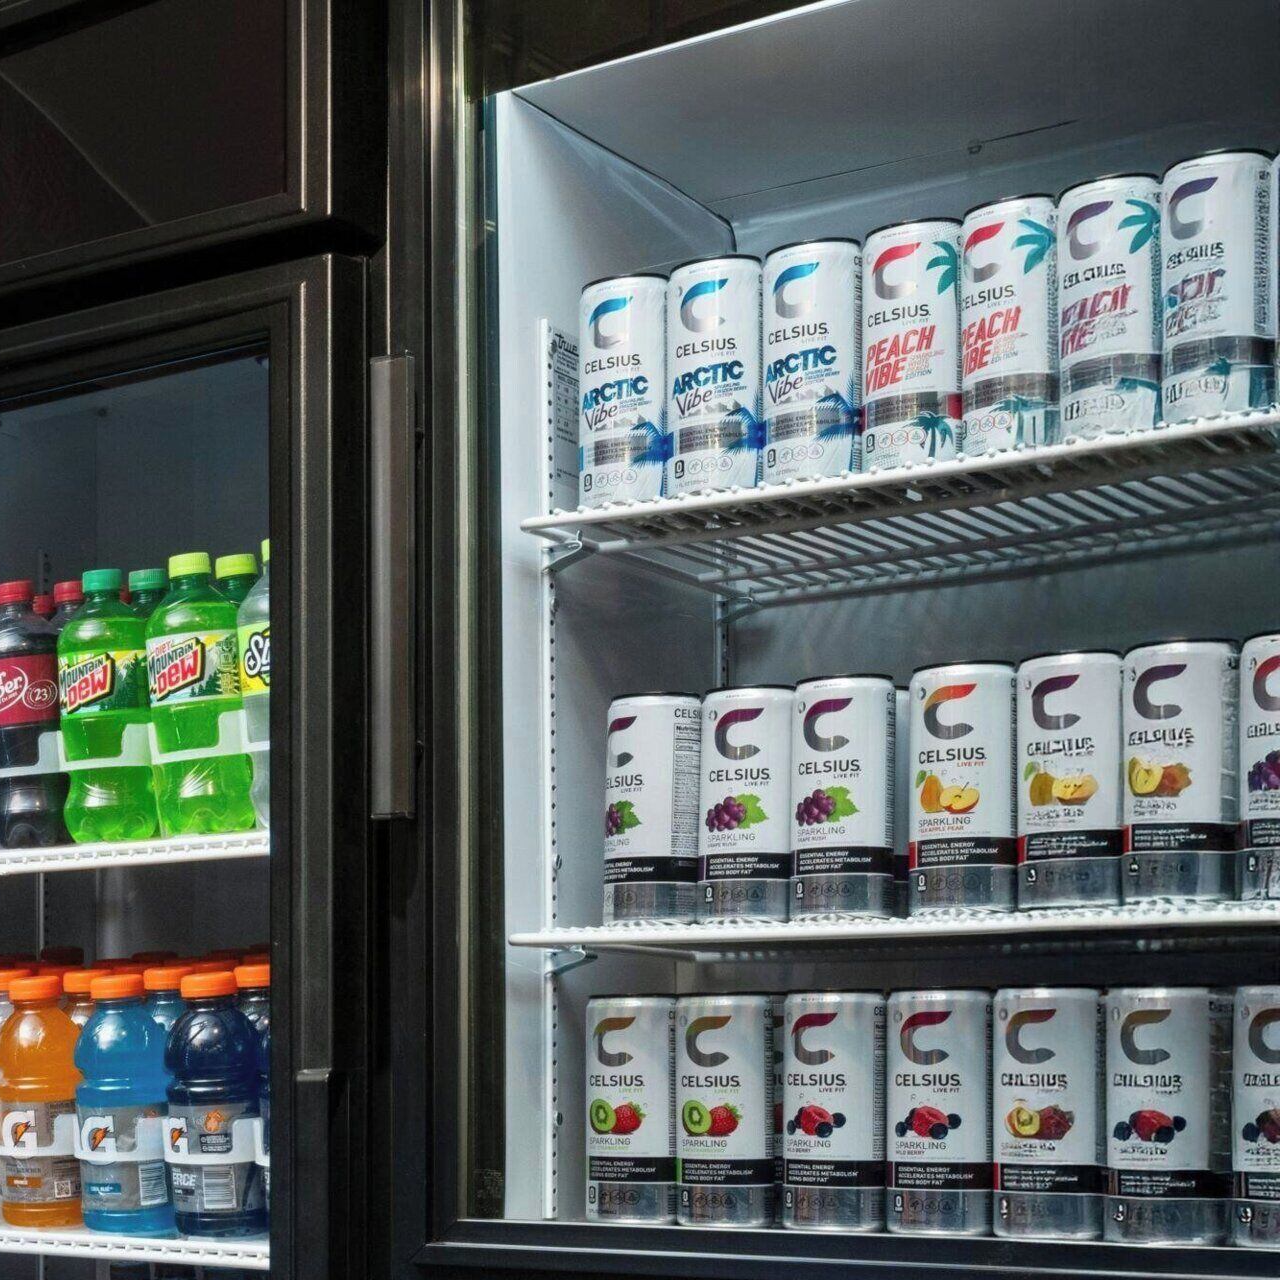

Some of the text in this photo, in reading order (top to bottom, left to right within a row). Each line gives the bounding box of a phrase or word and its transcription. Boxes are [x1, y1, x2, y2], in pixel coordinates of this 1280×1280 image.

[868, 304, 930, 327] CELSIUS
[866, 326, 936, 371] PEACH
[766, 345, 837, 382] ARCTIC
[673, 360, 744, 395] ARCTIC
[866, 361, 905, 395] VIBE
[769, 375, 803, 405] Vibe
[918, 747, 987, 765] CELSIUS
[709, 768, 770, 783] CELSIUS
[799, 759, 861, 775] CELSIUS
[797, 826, 846, 836] SPARKLING
[918, 816, 971, 827] SPARKLING
[707, 832, 755, 842] SPARKLING
